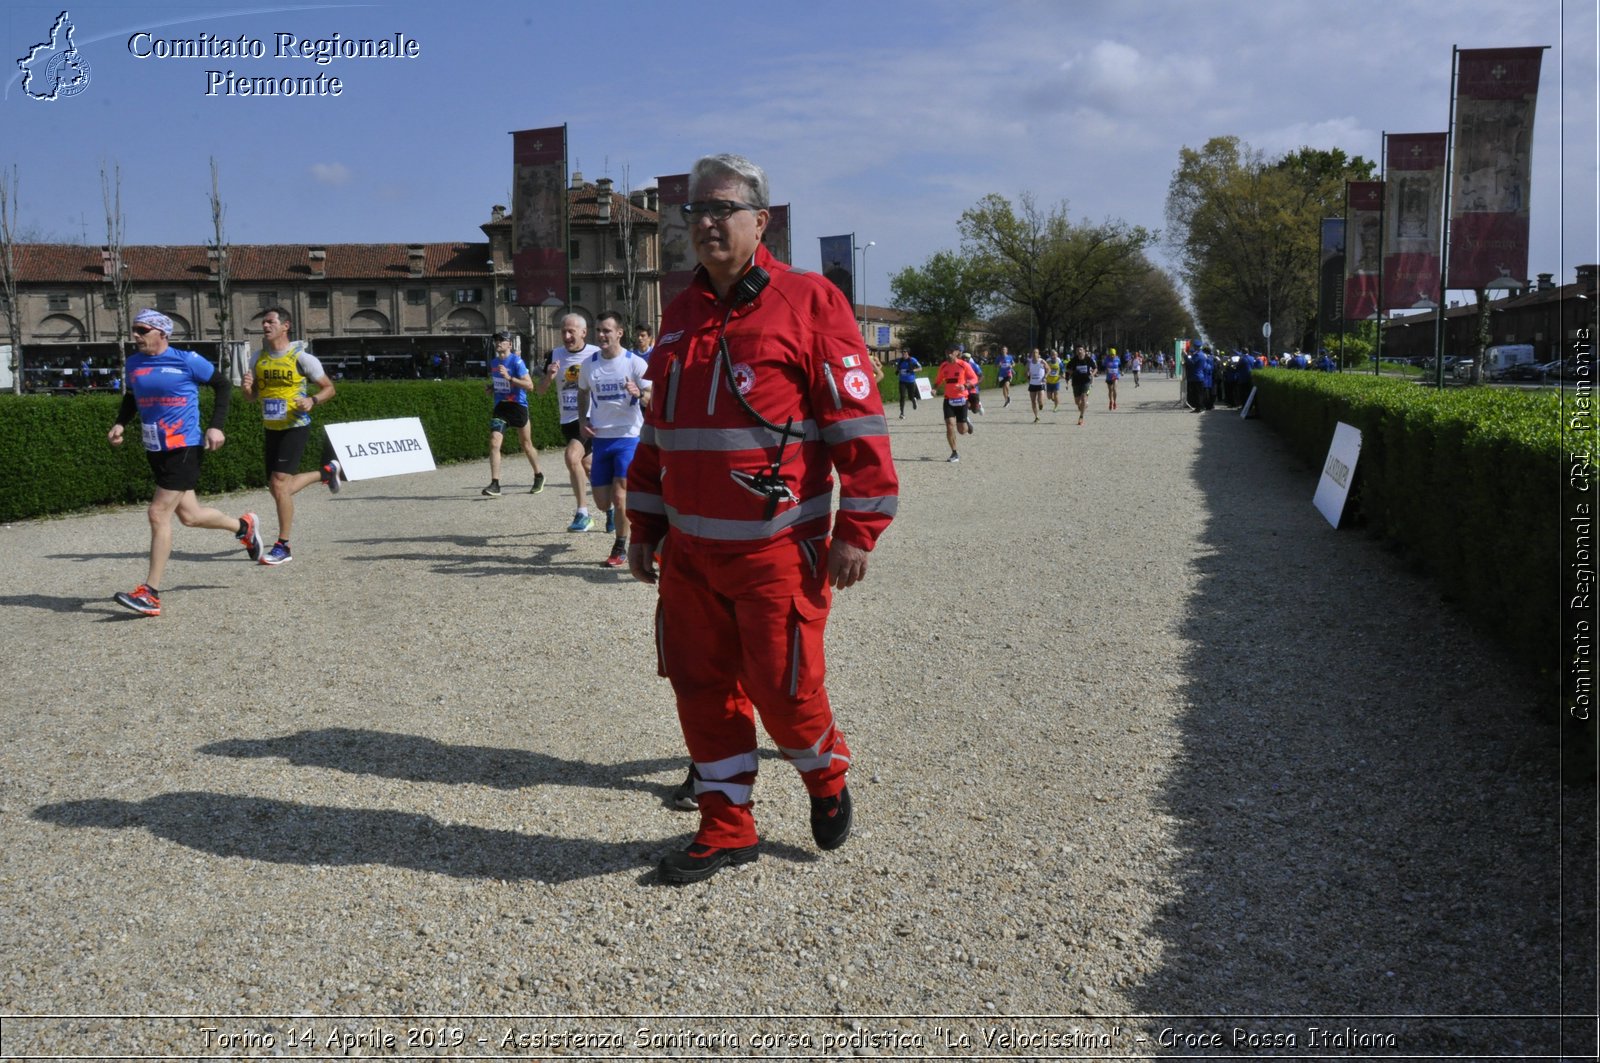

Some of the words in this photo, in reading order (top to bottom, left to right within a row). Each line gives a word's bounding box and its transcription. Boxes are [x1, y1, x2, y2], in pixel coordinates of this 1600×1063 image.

[263, 369, 293, 380] BIELLA
[345, 443, 368, 458] LA
[368, 438, 422, 455] STAMPA
